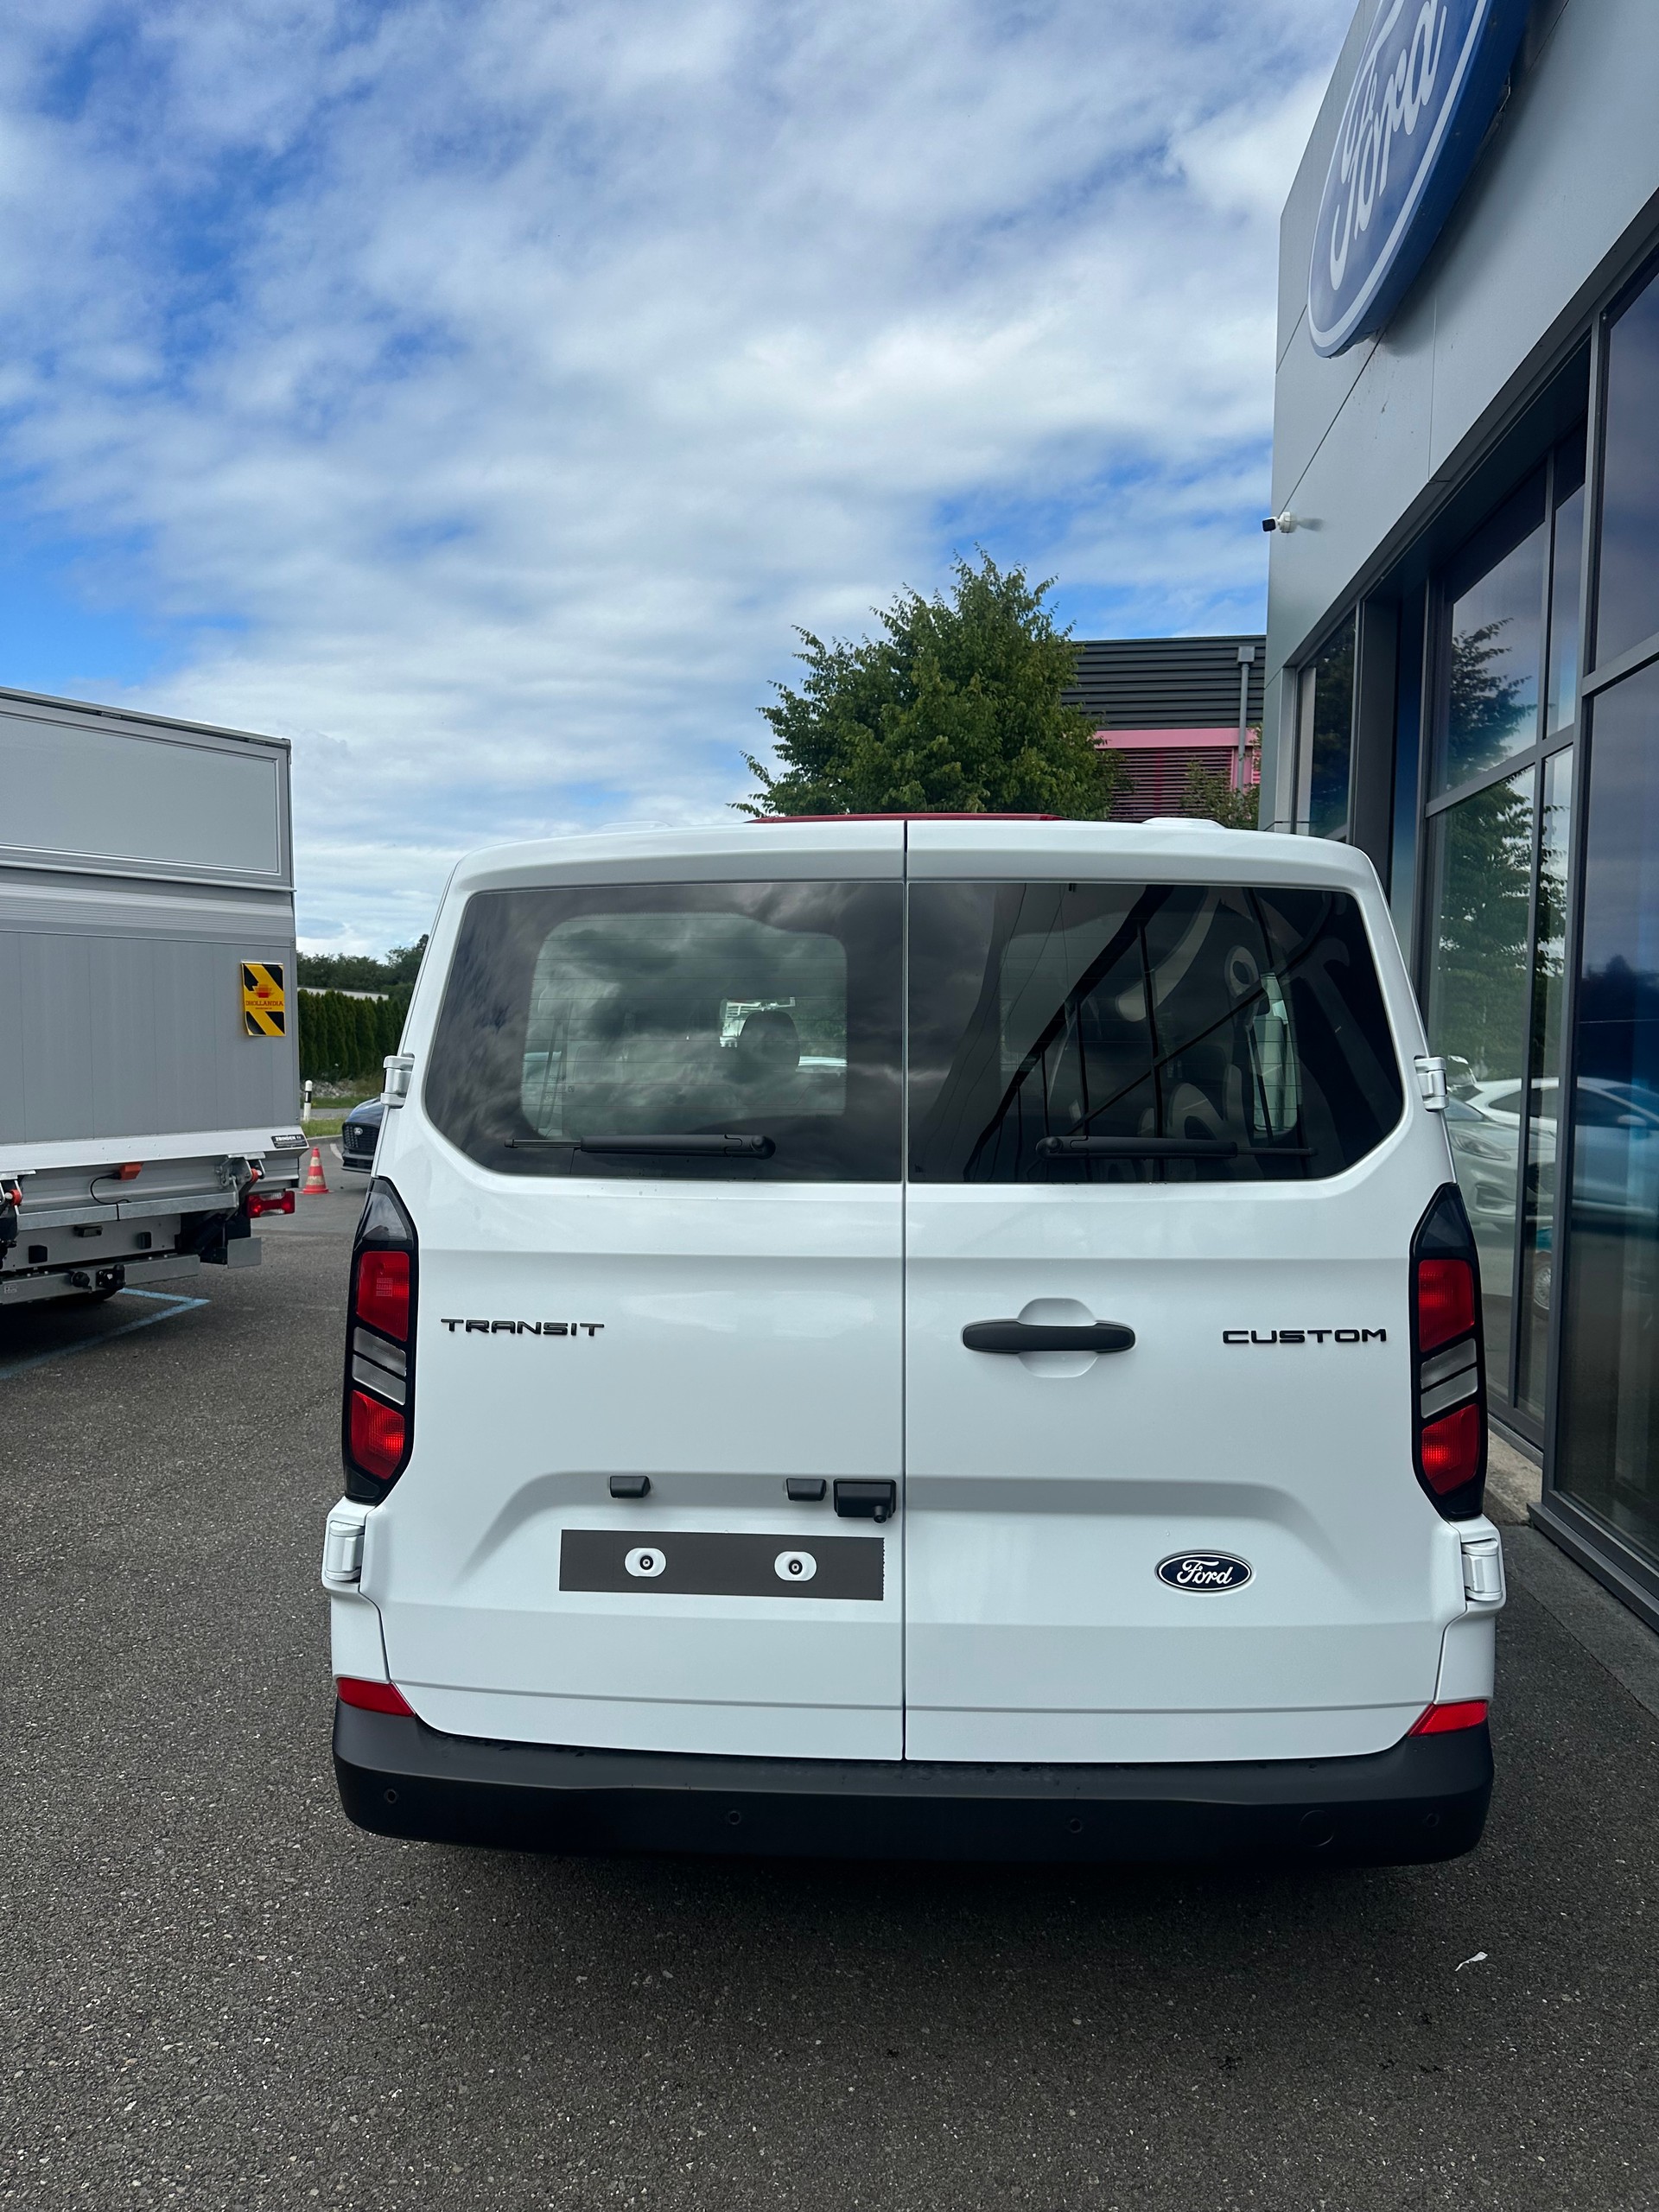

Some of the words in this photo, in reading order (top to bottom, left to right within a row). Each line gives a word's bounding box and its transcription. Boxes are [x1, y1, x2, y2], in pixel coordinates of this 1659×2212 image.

[1330, 0, 1447, 290] Ford
[440, 1318, 605, 1337] TRANSIT
[1222, 1328, 1387, 1344] CUSTOM
[1176, 1559, 1234, 1585] Ford
